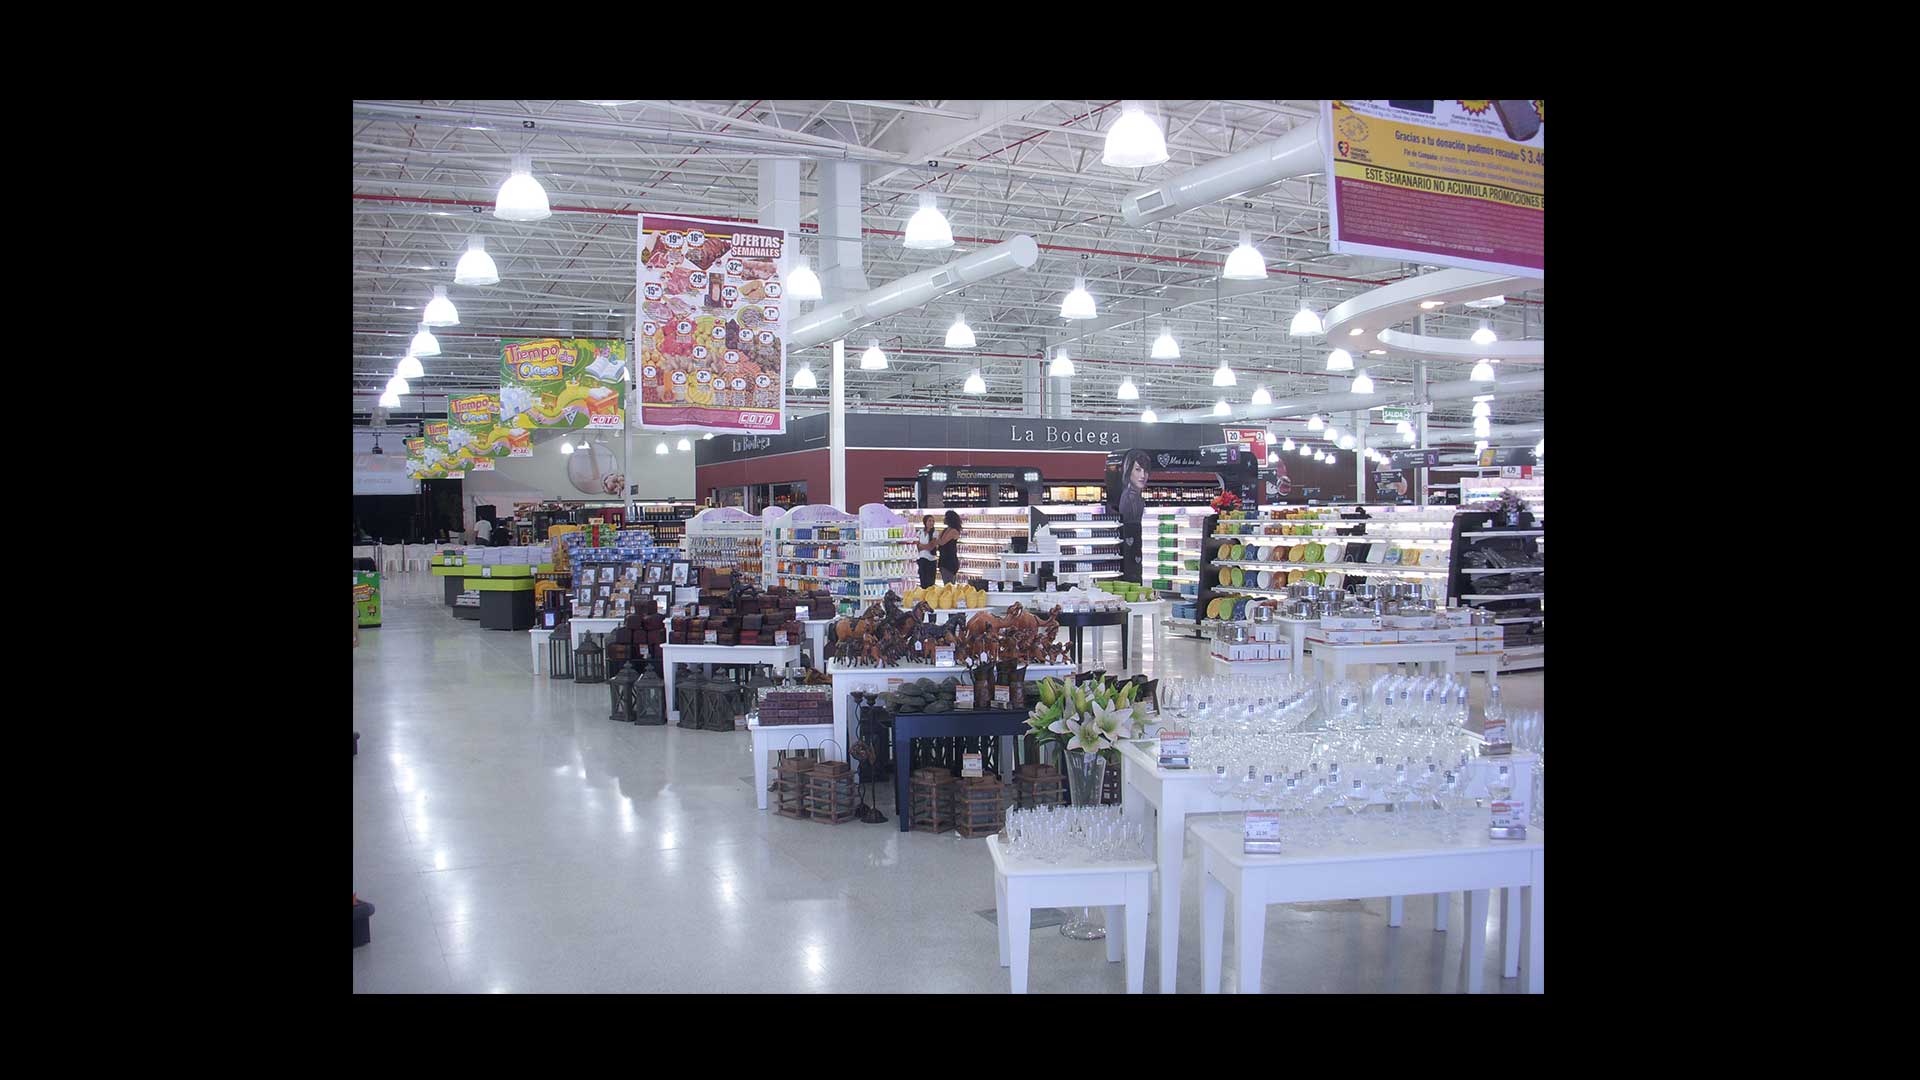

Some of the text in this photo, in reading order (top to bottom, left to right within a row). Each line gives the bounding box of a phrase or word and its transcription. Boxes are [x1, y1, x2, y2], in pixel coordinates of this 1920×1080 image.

[1395, 130, 1420, 144] Gracias
[1427, 135, 1435, 146] tu
[1520, 148, 1526, 162] $
[1366, 168, 1383, 182] ESTE
[1385, 171, 1431, 190] SEMANARIO
[1433, 179, 1445, 192] NO
[1447, 182, 1487, 197] ACUMULA
[1489, 187, 1540, 208] PROMOCIONES
[732, 233, 780, 248] OFERTAS
[731, 246, 780, 257] SEMANALES
[504, 343, 574, 364] Tiempo de
[451, 398, 489, 415] Tiempo
[591, 415, 620, 425] COTO
[740, 412, 774, 424] COTO
[1011, 425, 1120, 446] La Bodega
[732, 438, 741, 452] La
